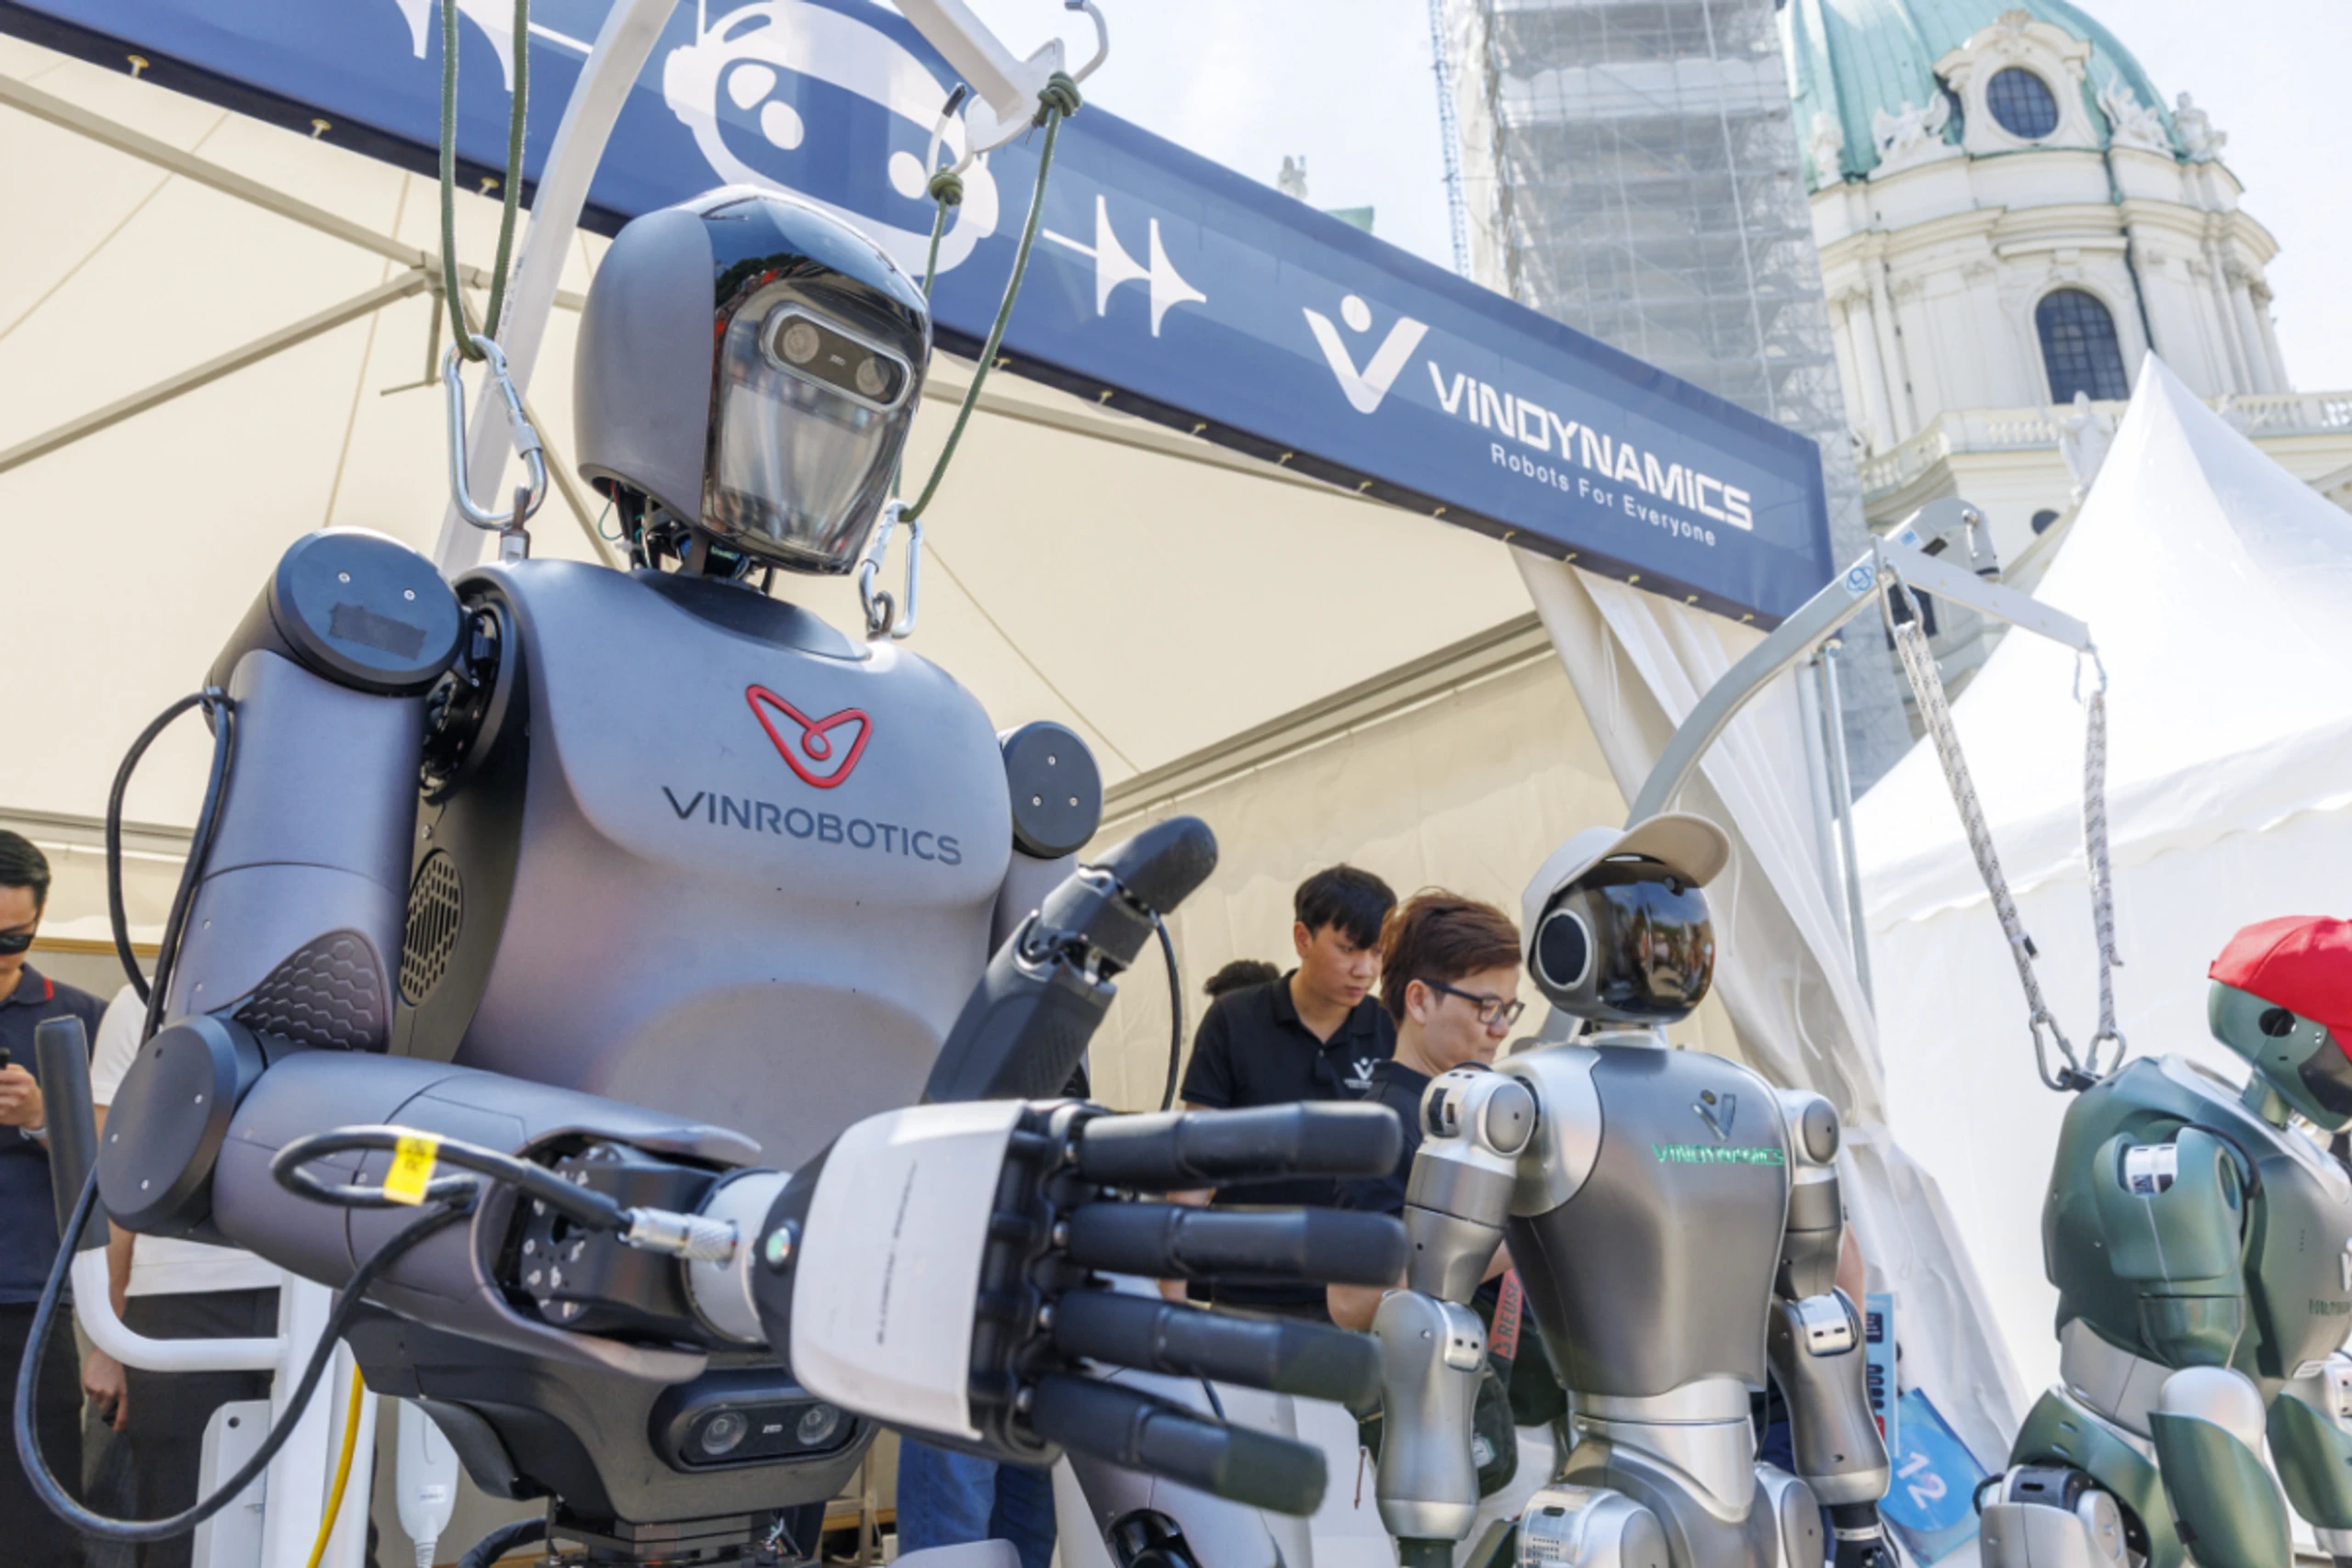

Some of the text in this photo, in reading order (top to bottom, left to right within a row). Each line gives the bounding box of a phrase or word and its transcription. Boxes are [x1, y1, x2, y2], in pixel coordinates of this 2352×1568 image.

[1427, 360, 1754, 532] VINDYNAMICS
[1490, 442, 1717, 547] Robots For Everyone
[661, 785, 962, 866] VINROBOTICS
[1497, 1279, 1521, 1338] REUSE
